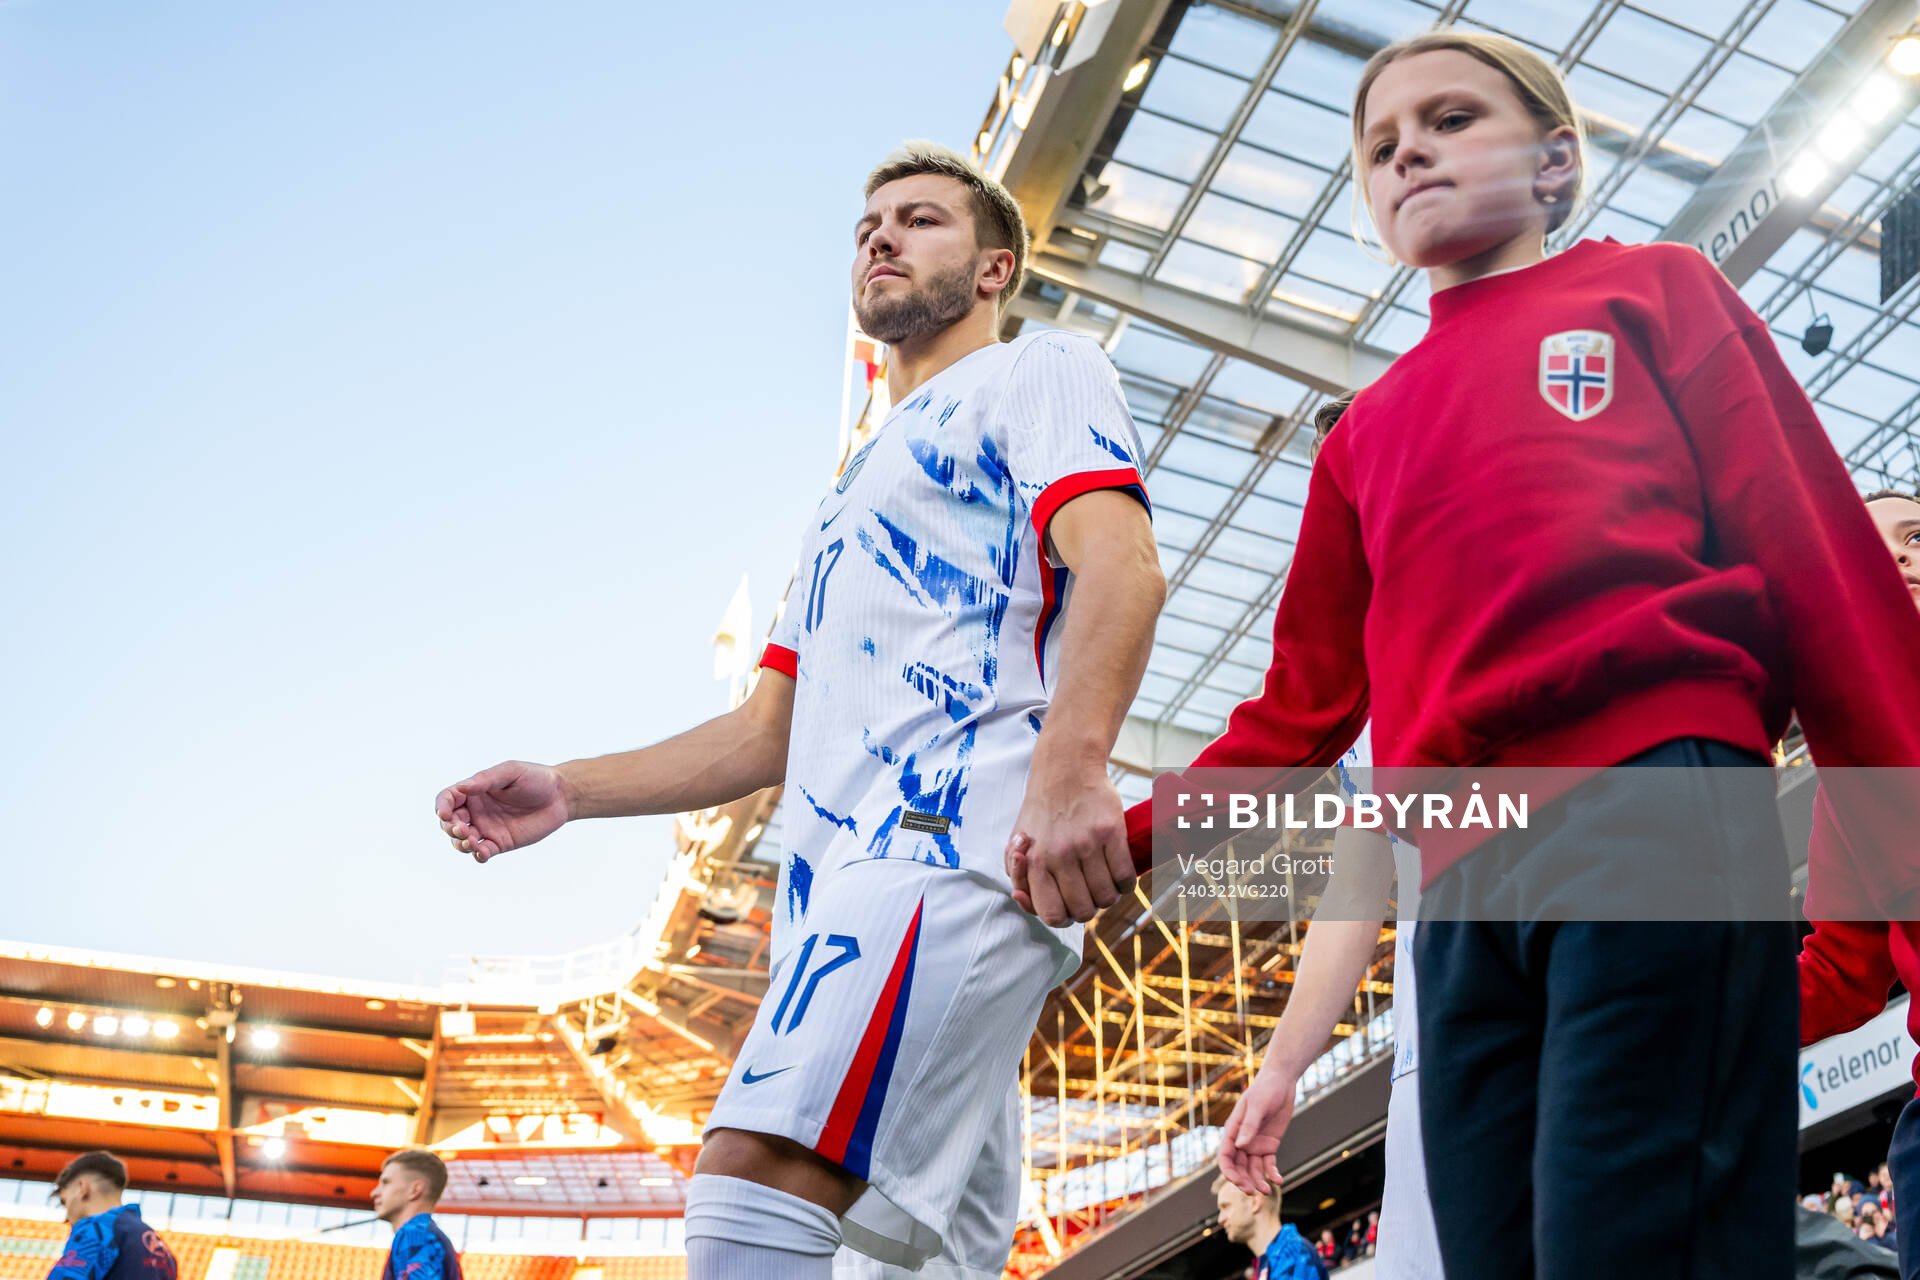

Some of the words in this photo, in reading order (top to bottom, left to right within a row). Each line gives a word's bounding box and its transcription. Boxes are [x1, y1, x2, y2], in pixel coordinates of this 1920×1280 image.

[806, 537, 845, 634] 17
[771, 933, 862, 1036] 17
[1817, 1036, 1901, 1093] telenor
